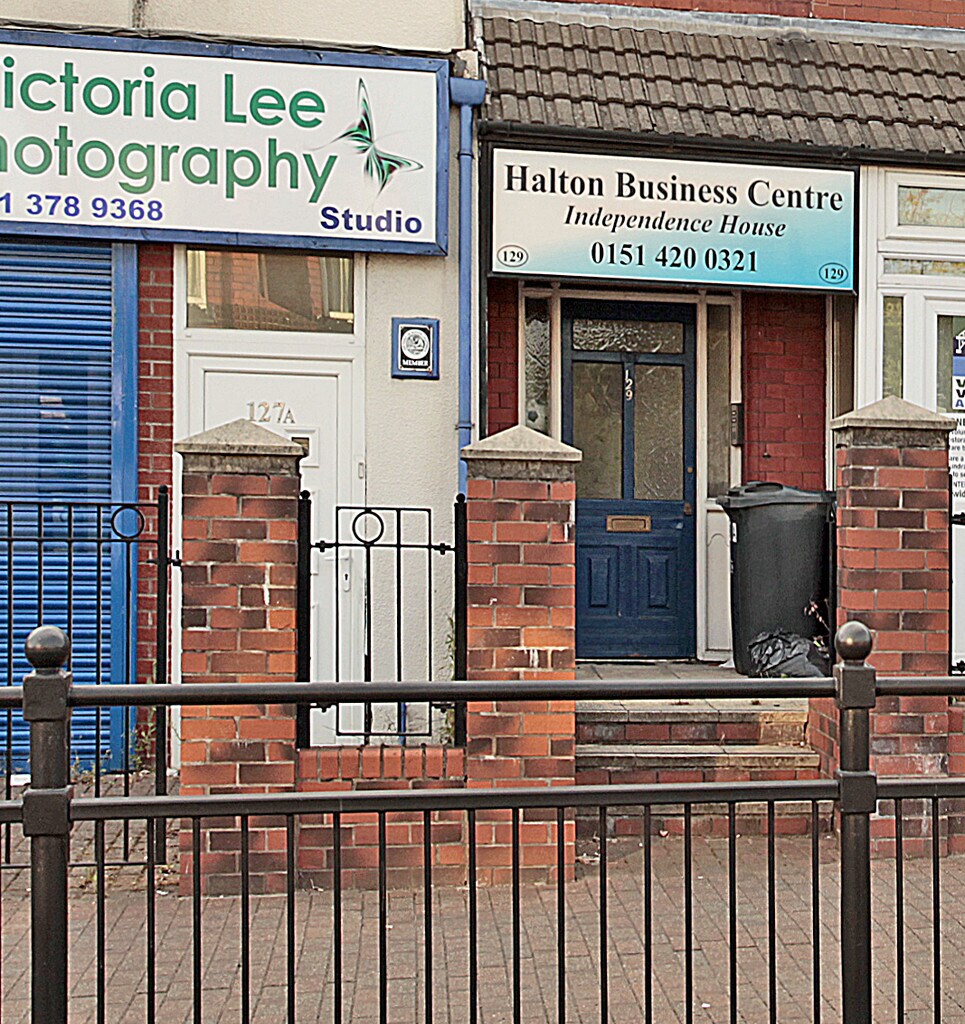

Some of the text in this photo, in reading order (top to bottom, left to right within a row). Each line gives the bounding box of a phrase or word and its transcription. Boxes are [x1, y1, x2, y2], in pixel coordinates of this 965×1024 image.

[224, 73, 326, 128] Lee
[504, 163, 844, 212] Halton Business Centre
[26, 193, 81, 218] 378
[91, 196, 164, 222] 9368
[319, 205, 423, 235] Studio
[564, 205, 787, 238] Independence House
[502, 250, 524, 263] 129
[591, 241, 758, 273] 0151 420 0321
[824, 267, 844, 280] 129
[625, 369, 633, 401] 129
[246, 401, 295, 423] 127A
